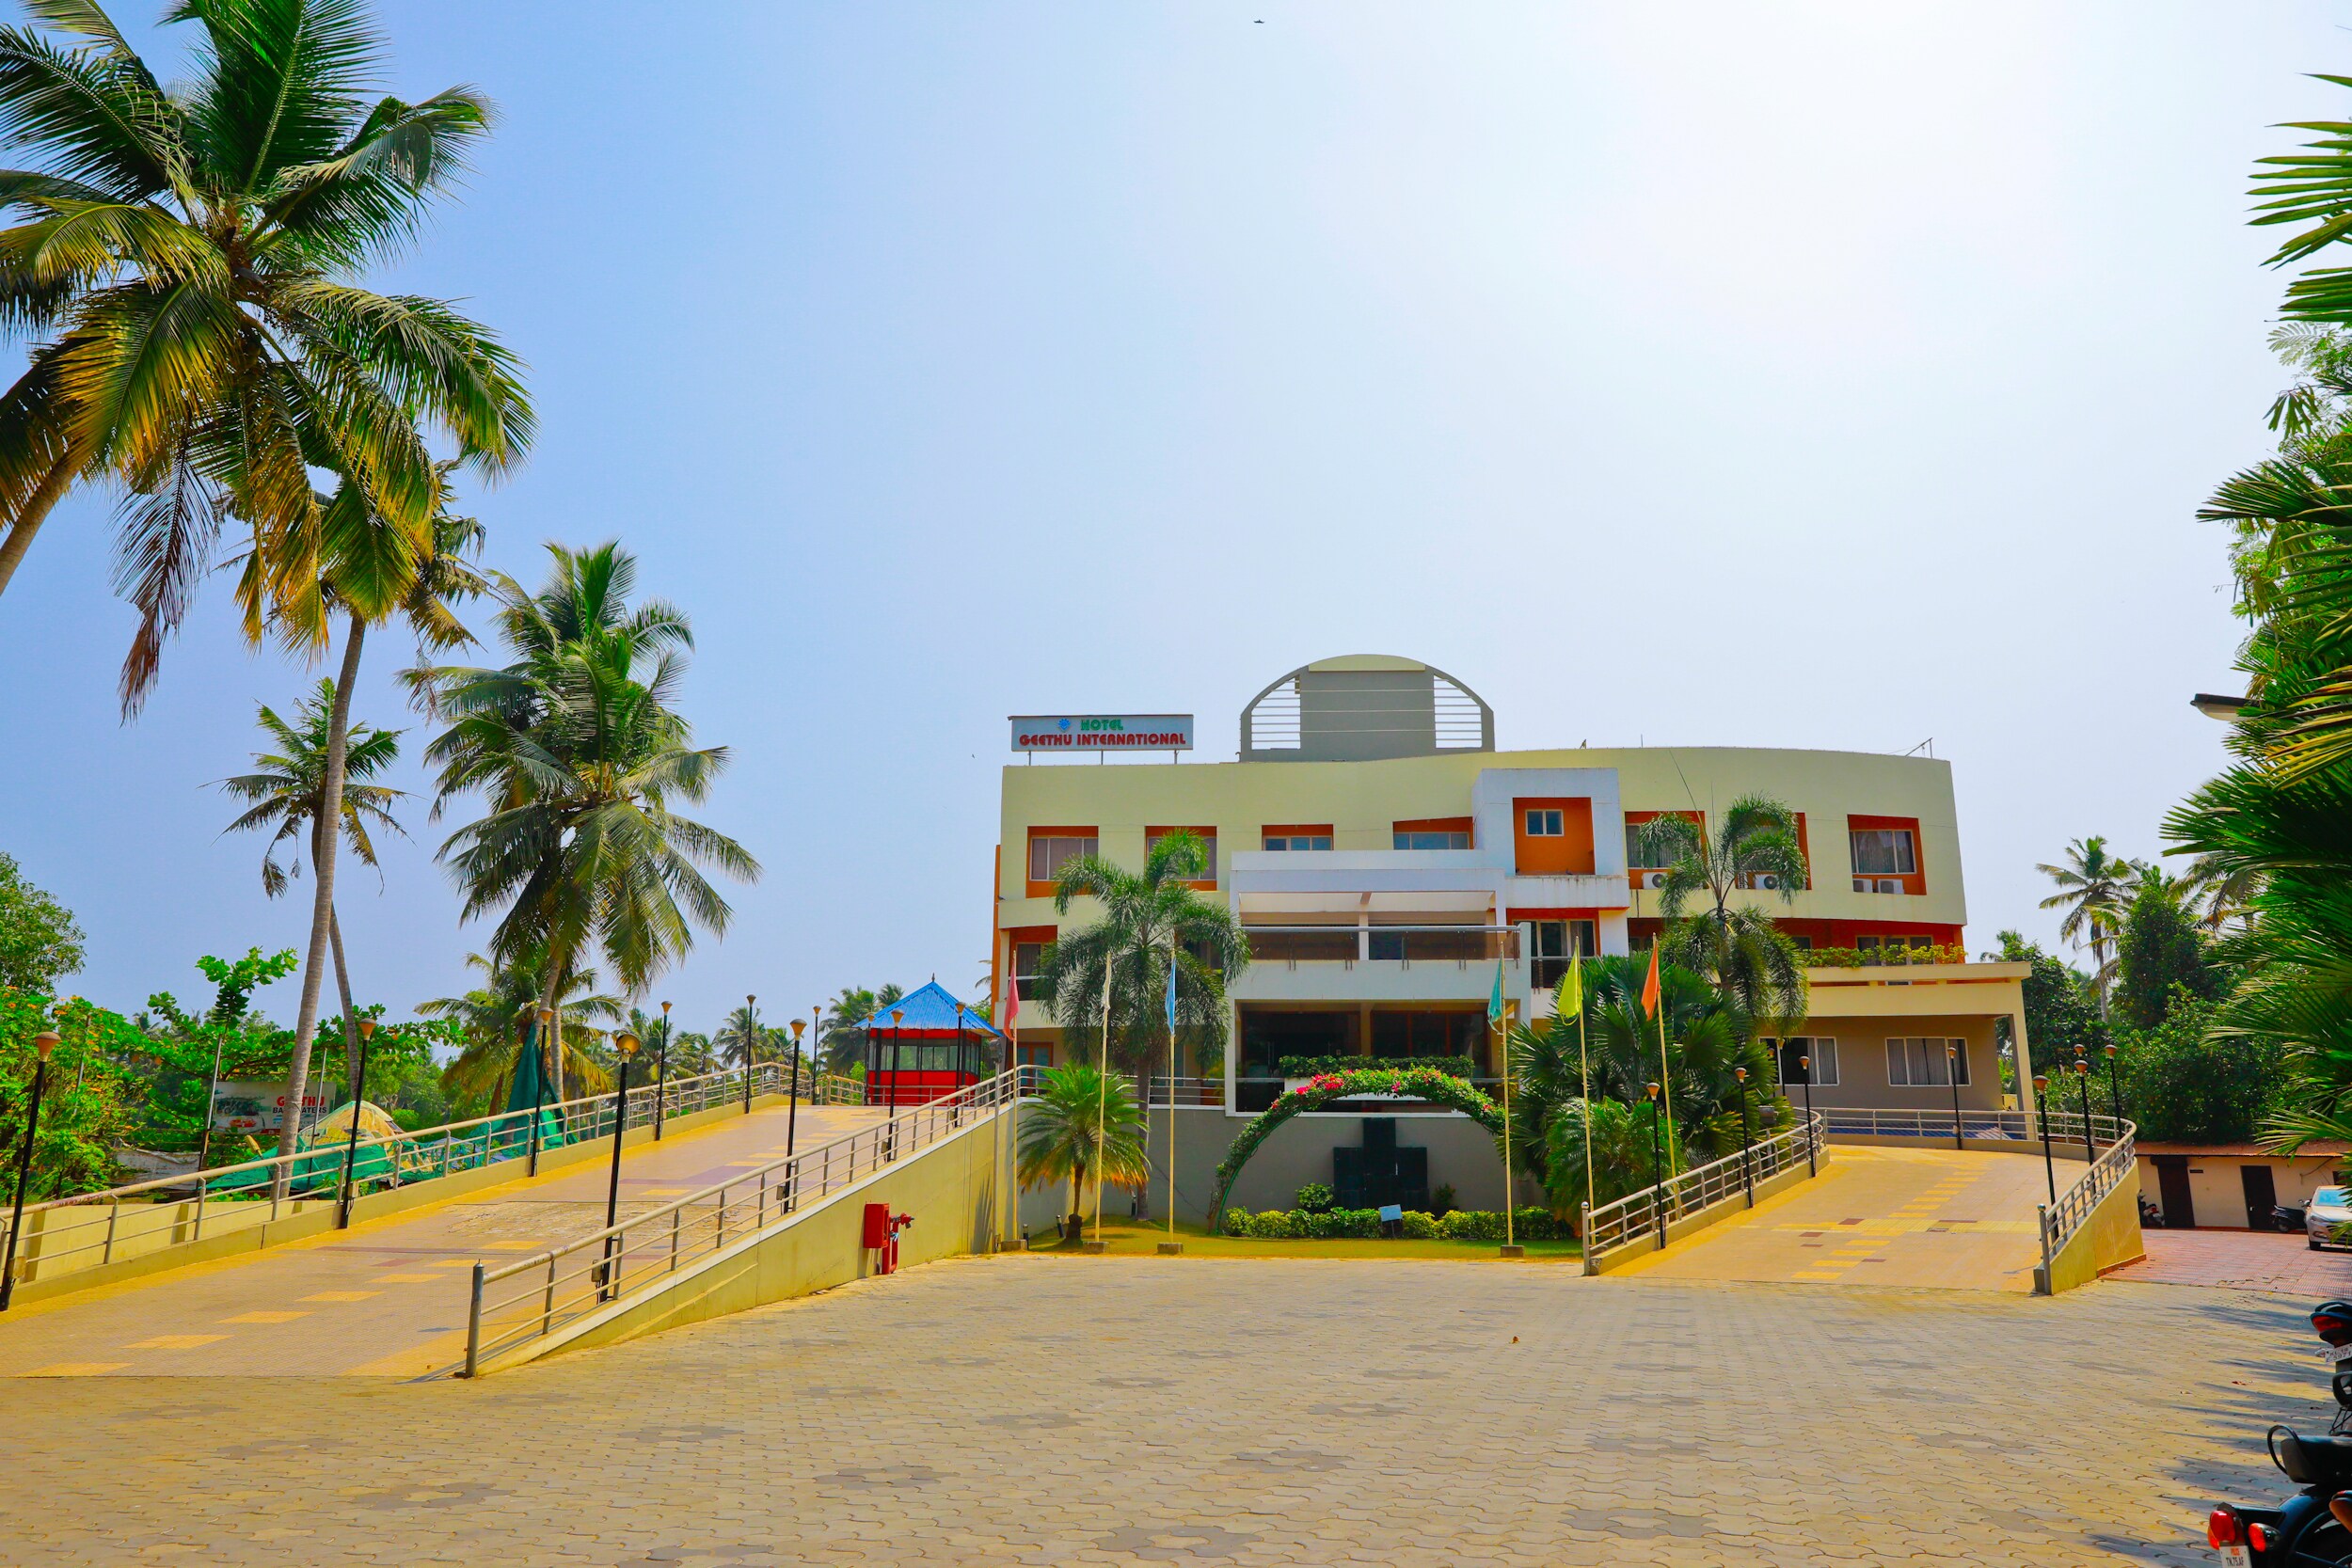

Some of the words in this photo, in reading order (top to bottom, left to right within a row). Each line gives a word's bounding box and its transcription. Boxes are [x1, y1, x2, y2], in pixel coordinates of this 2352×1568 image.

[1080, 719, 1124, 732] HOTEL
[1019, 734, 1073, 747] GEETHU
[1076, 733, 1186, 746] INTERNATIONAL
